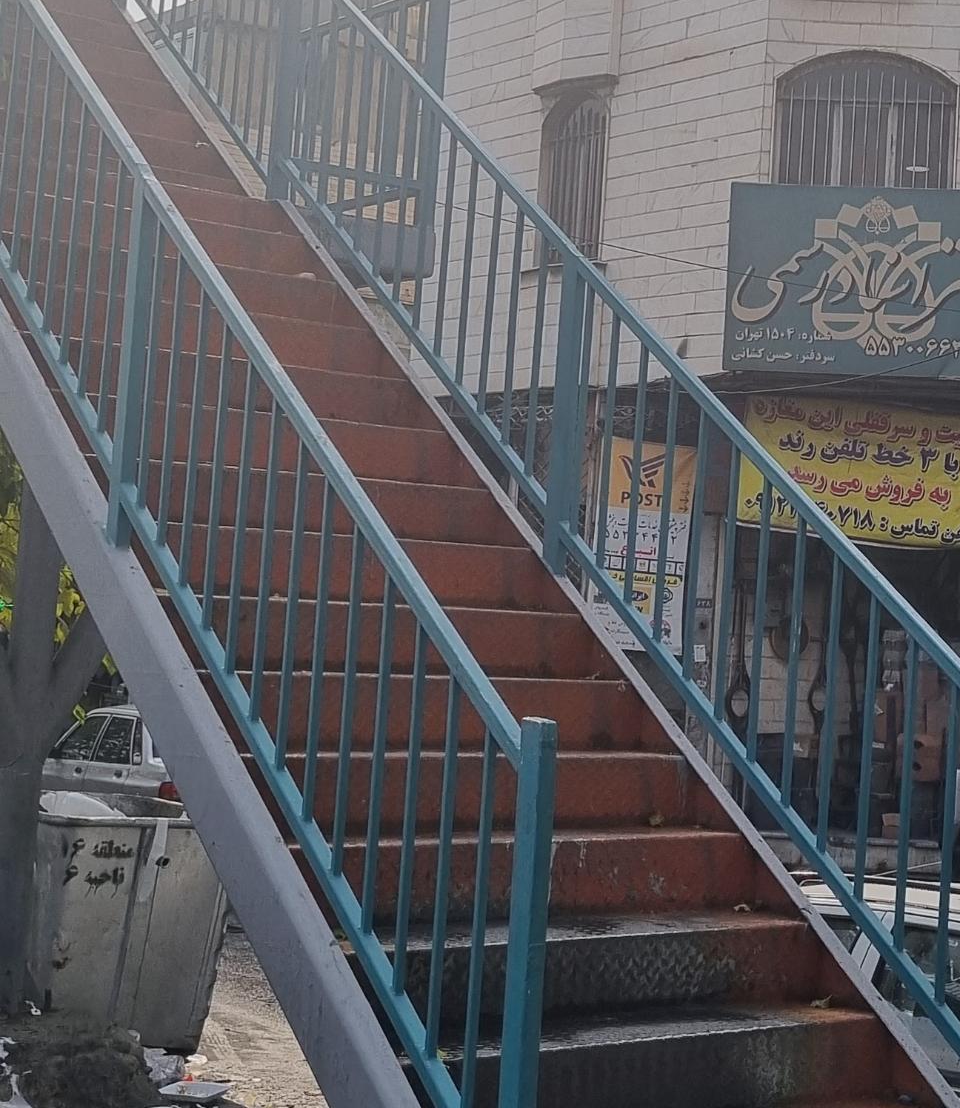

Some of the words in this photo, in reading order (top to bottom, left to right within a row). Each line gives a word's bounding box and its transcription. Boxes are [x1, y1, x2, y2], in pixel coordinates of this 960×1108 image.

[735, 327, 763, 342] تهران
[767, 327, 795, 341] ۱۵۰۴
[766, 350, 794, 362] حسن
[753, 400, 807, 424] مغازه
[808, 405, 842, 431] این
[778, 430, 817, 459] رند
[920, 429, 932, 445] و
[820, 439, 868, 463] تلفن
[871, 441, 913, 466] خط
[919, 446, 939, 473] ۳
[943, 451, 960, 480] با
[786, 465, 828, 493] رسد
[830, 473, 863, 495] می
[865, 474, 926, 506] فروش
[928, 484, 953, 511] به
[890, 517, 940, 539] تماس
